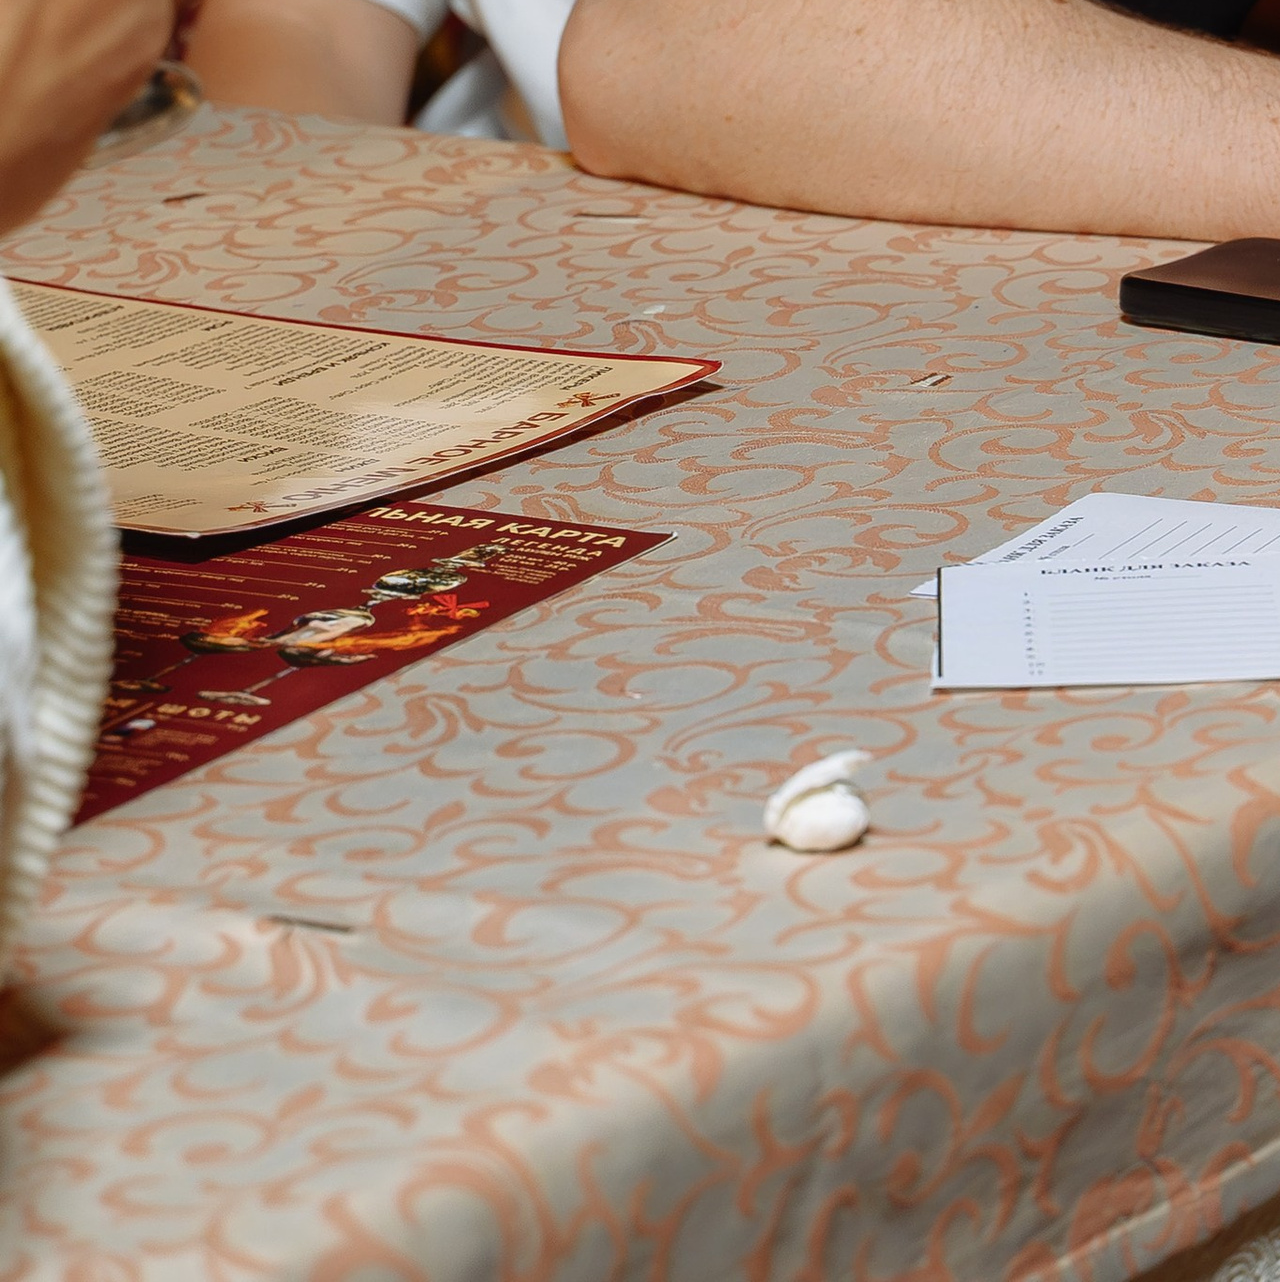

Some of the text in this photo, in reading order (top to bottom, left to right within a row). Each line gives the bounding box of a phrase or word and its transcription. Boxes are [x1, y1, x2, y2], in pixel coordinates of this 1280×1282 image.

[404, 411, 570, 466] БАРНОЕ
[282, 467, 420, 501] МЕНЮ
[490, 537, 602, 557] ЛЕГЕНДА
[495, 522, 628, 548] КАРТА
[1041, 565, 1115, 575] БЛАНК
[1170, 561, 1251, 569] ЗАКАЗА
